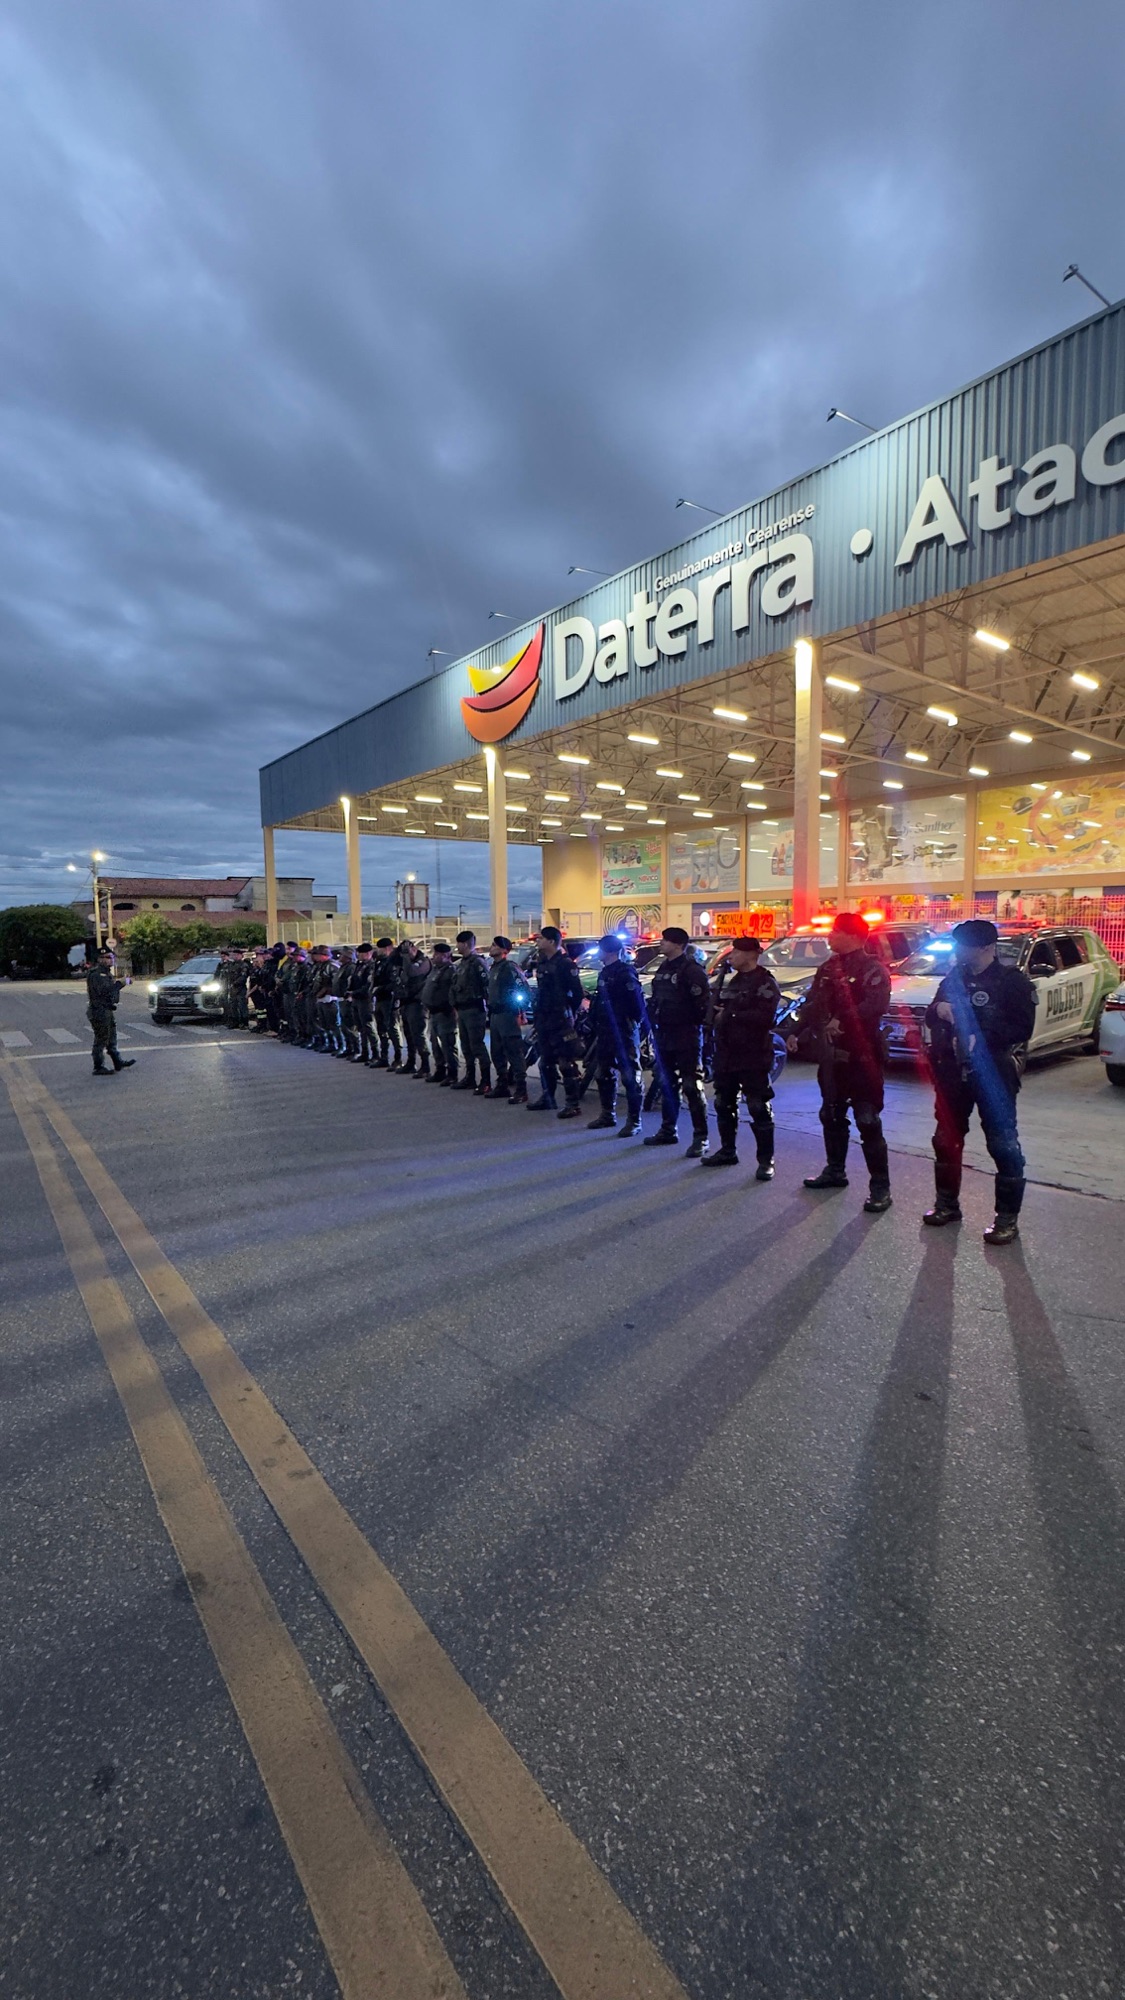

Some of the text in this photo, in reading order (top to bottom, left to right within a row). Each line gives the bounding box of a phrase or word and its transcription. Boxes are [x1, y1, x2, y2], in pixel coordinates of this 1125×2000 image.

[653, 503, 815, 592] Genuinamente Cearense
[554, 533, 814, 701] Daterra
